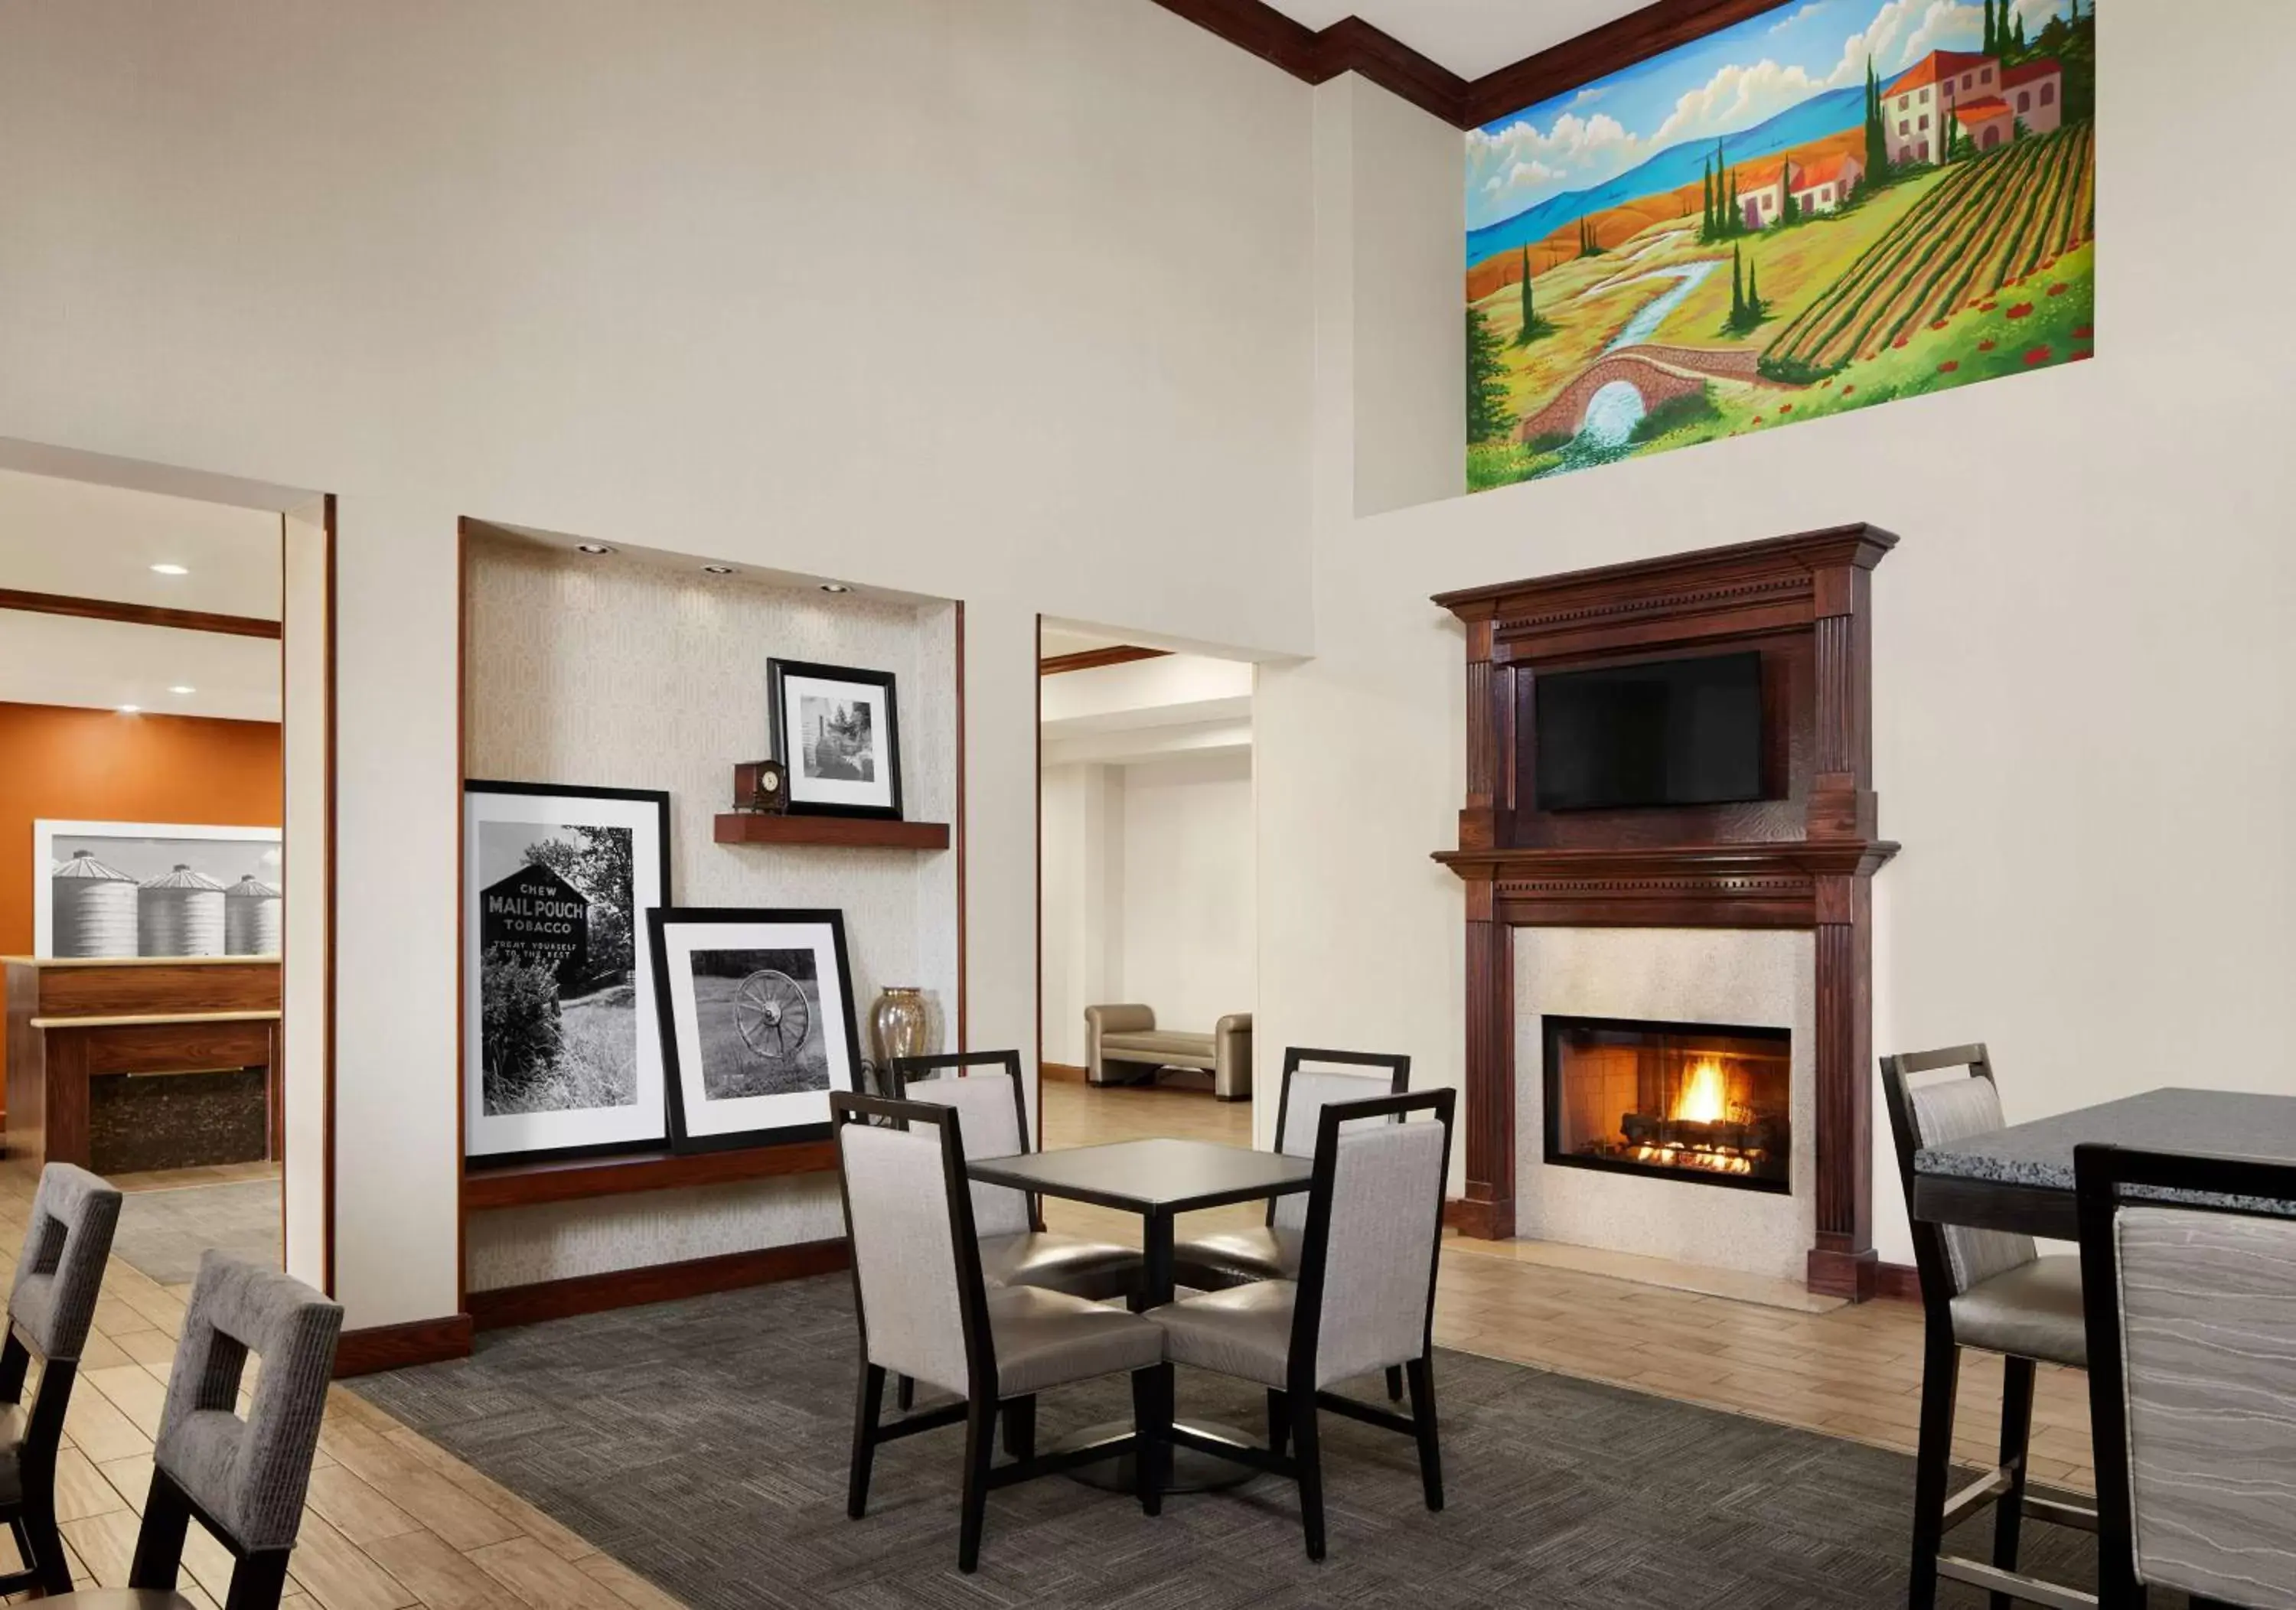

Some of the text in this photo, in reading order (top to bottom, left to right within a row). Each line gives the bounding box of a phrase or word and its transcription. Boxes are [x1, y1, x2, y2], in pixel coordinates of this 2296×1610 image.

[520, 884, 557, 896] CHEW
[489, 895, 583, 919] MAIL POUCH
[504, 919, 572, 934] TOBACCO
